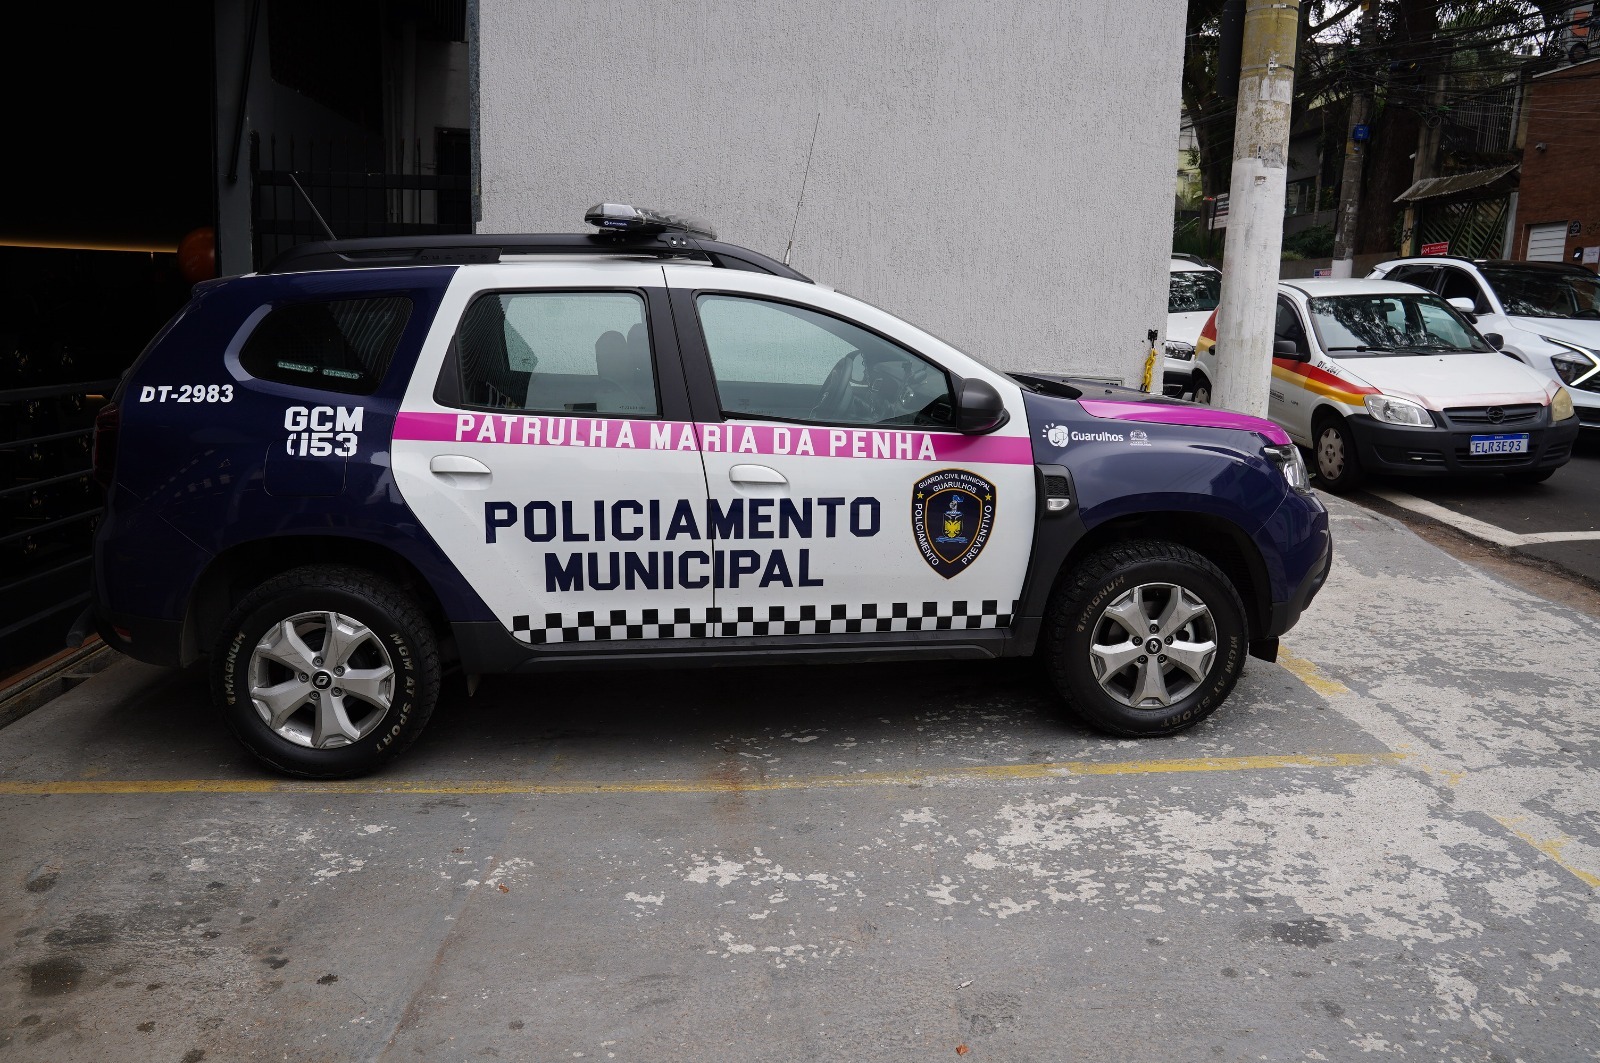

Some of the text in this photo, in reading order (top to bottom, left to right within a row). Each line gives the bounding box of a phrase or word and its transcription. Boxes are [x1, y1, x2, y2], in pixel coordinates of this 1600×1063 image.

[140, 384, 234, 403] DT-2983
[284, 406, 364, 432] GCM
[455, 414, 937, 460] PATRULHA MARIA DA PENHA
[1071, 431, 1124, 442] Guarulhos
[1475, 441, 1521, 453] ELR3E93
[918, 474, 944, 489] GUARDA
[960, 474, 990, 491] MUNICIPAL
[933, 481, 977, 494] GUARULHOS
[484, 496, 881, 544] POLICIAMENTO
[915, 503, 939, 566] POLICIAMENTO
[961, 505, 993, 565] PREVENTIVO
[544, 549, 824, 592] MUNICIPAL
[1080, 575, 1125, 627] MAGNUM
[223, 631, 247, 693] MAGNUM
[390, 631, 414, 671] MGM
[375, 702, 412, 752] SPORT
